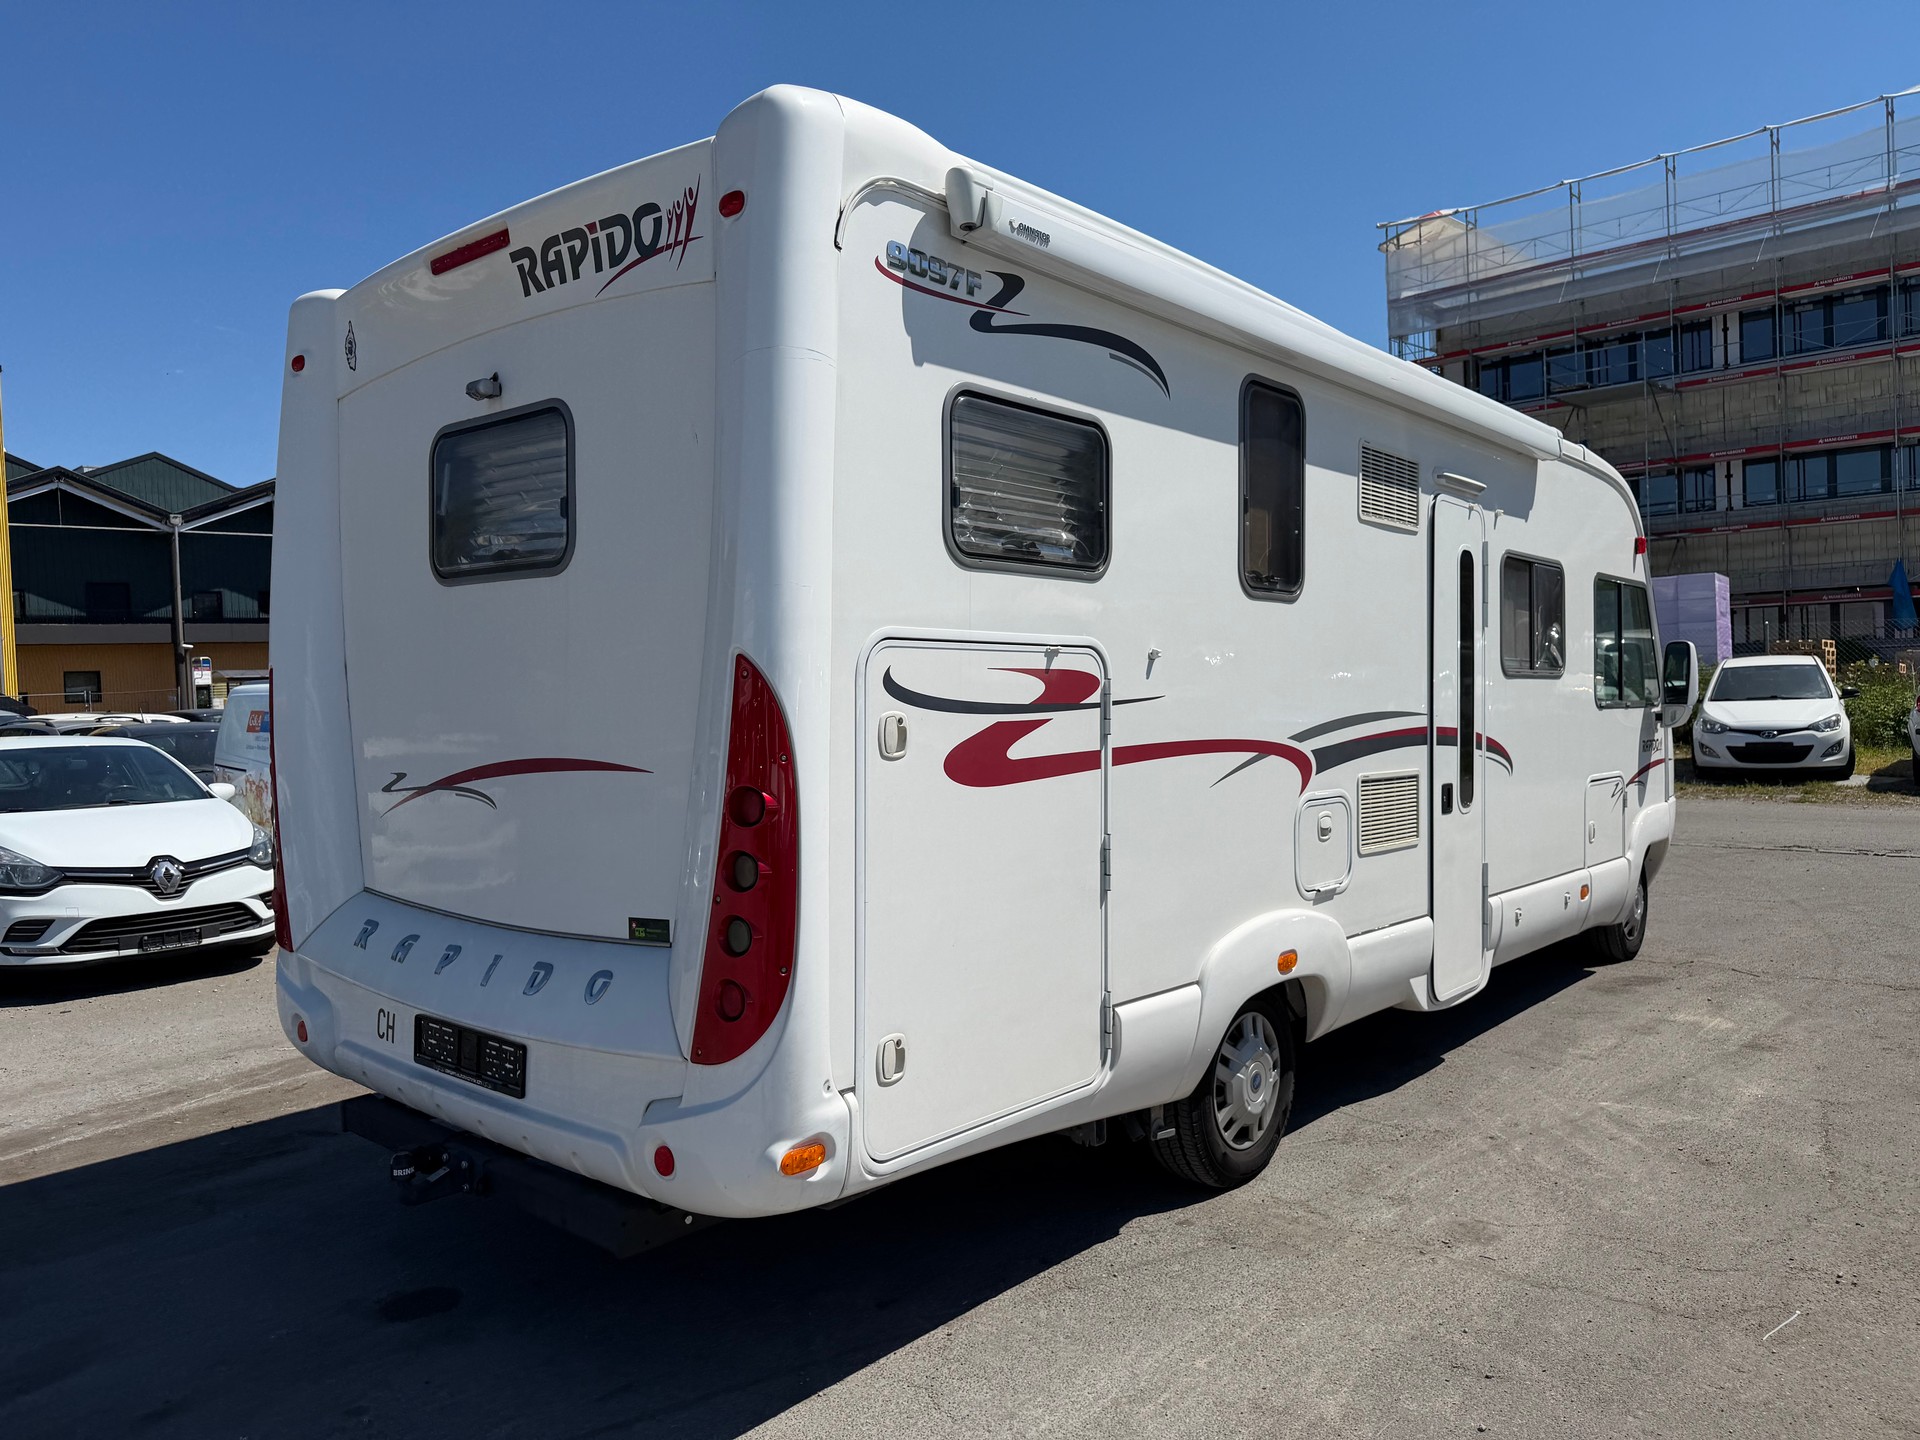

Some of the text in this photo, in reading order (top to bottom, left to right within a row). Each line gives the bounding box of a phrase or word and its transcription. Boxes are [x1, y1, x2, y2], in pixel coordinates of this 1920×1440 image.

[1017, 222, 1051, 244] OMNISTOR
[886, 239, 982, 298] 9097F
[353, 918, 614, 1006] RAPIDO
[376, 1007, 396, 1044] CH
